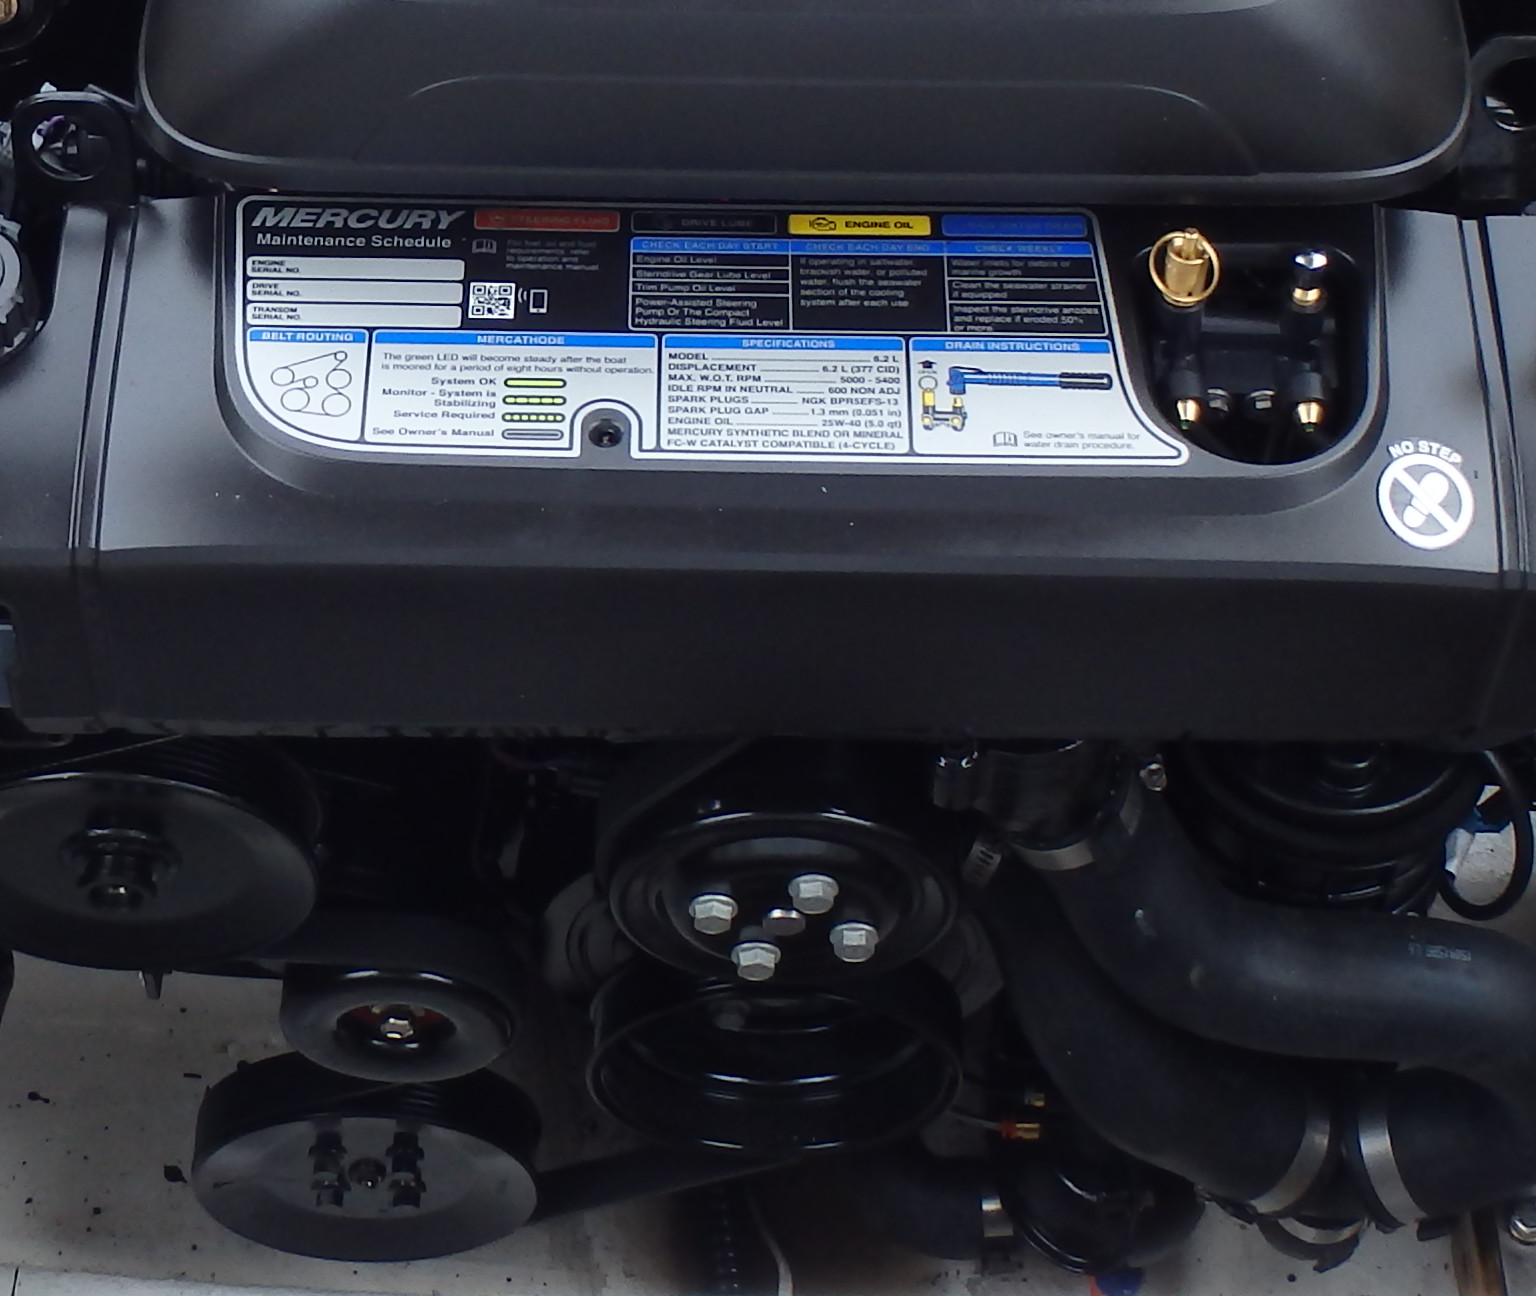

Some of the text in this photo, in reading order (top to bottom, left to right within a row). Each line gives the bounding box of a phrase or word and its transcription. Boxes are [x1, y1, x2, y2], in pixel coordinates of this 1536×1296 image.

[251, 207, 466, 229] MERCURY
[894, 221, 913, 229] OIL
[257, 233, 451, 248] Maintenance Schedule
[684, 241, 715, 249] EACH
[636, 256, 670, 264] Engine
[660, 284, 690, 293] Pump
[635, 298, 757, 309] Power-Assisted Steering
[635, 308, 664, 317] Pump
[667, 308, 681, 316] Or
[705, 309, 750, 317] Compact
[635, 318, 682, 327] Hydraulic
[685, 318, 726, 327] Steering
[756, 319, 783, 327] Level
[262, 332, 354, 341] BELT ROUTING
[477, 335, 565, 345] MERCATHODE
[742, 339, 835, 348] SPECIFICATIONS
[945, 341, 1080, 352] DRAIN INSTRUCTIONS
[384, 352, 402, 360] The
[405, 354, 434, 362] green
[524, 355, 556, 364] steady
[604, 356, 627, 364] boat
[668, 352, 899, 363] MODEL 6.2 L
[459, 364, 492, 373] period
[507, 365, 532, 373] eight
[566, 365, 602, 373] without
[604, 366, 655, 375] operation.
[668, 363, 756, 372] DISPLACEMENT
[850, 366, 873, 374] (377
[877, 366, 900, 374] CID)
[431, 377, 497, 386] System OK
[668, 374, 696, 382] MAX.
[439, 389, 483, 398] System
[668, 385, 693, 393] IDLE
[696, 385, 721, 393] RPM
[740, 386, 793, 394] NEUTRAL
[434, 399, 497, 408] Stabilizing
[710, 396, 749, 404] PLUGS
[802, 397, 827, 405] NGK
[394, 410, 495, 420] Service Required
[668, 406, 706, 414] SPARK
[852, 409, 883, 417] (0.051
[887, 409, 901, 417] in)
[668, 417, 711, 425] ENGINE
[821, 419, 861, 427] 25W-40
[864, 420, 883, 428] (5.0
[887, 420, 902, 428] qt)
[373, 427, 494, 437] See Owner's Manual
[667, 428, 723, 436] MERCURY
[726, 428, 790, 437] SYNTHETIC
[833, 430, 849, 438] OR
[852, 431, 903, 439] MINERAL
[1023, 431, 1140, 441] See owner's manual for
[667, 439, 895, 450] FC-W CATALYST COMPATIBLE (4-CYCLE)
[1054, 441, 1079, 449] drain
[1081, 442, 1134, 451] procedure.
[1388, 440, 1462, 464] NO STEP
